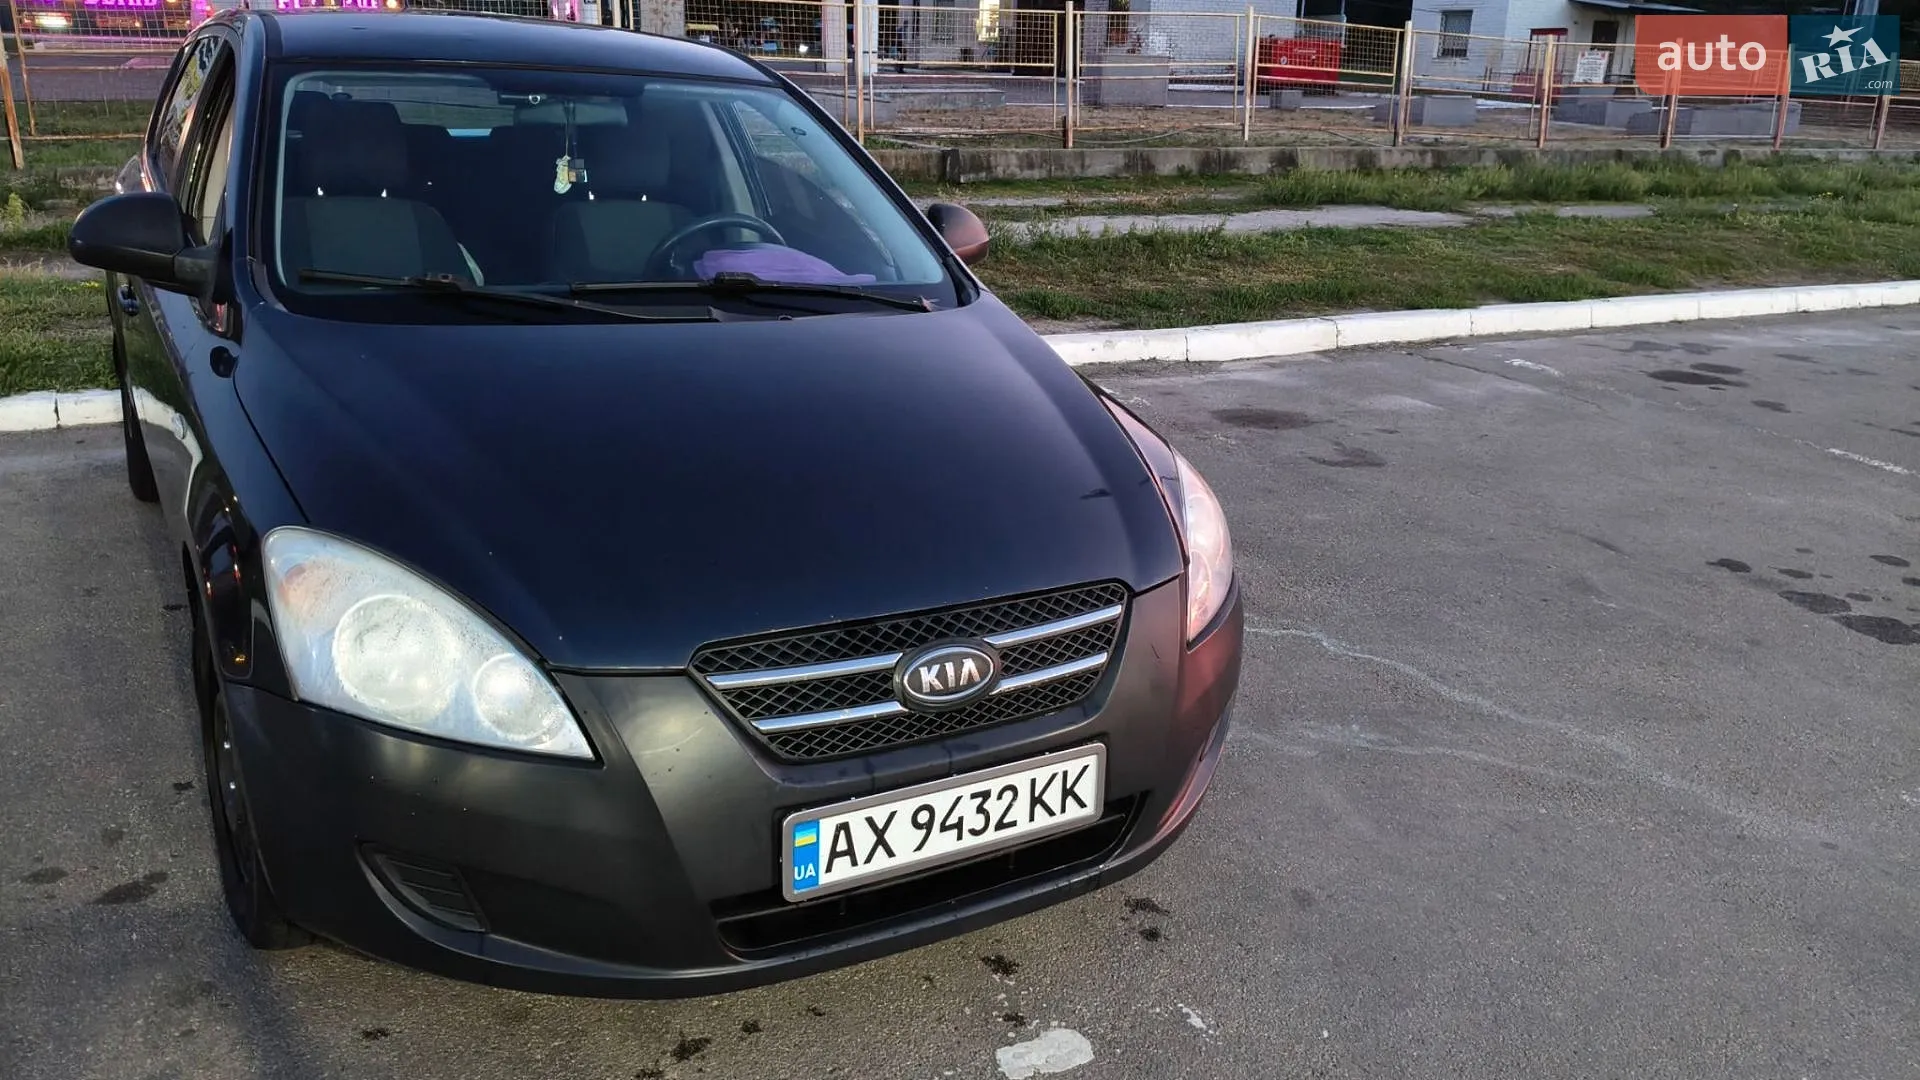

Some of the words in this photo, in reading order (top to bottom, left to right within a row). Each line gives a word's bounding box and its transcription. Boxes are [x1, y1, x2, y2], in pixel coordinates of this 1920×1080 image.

[918, 657, 981, 693] KIA
[824, 810, 898, 874] AX
[910, 783, 1018, 853] 9432
[1028, 764, 1090, 823] KK
[794, 864, 816, 881] UA
